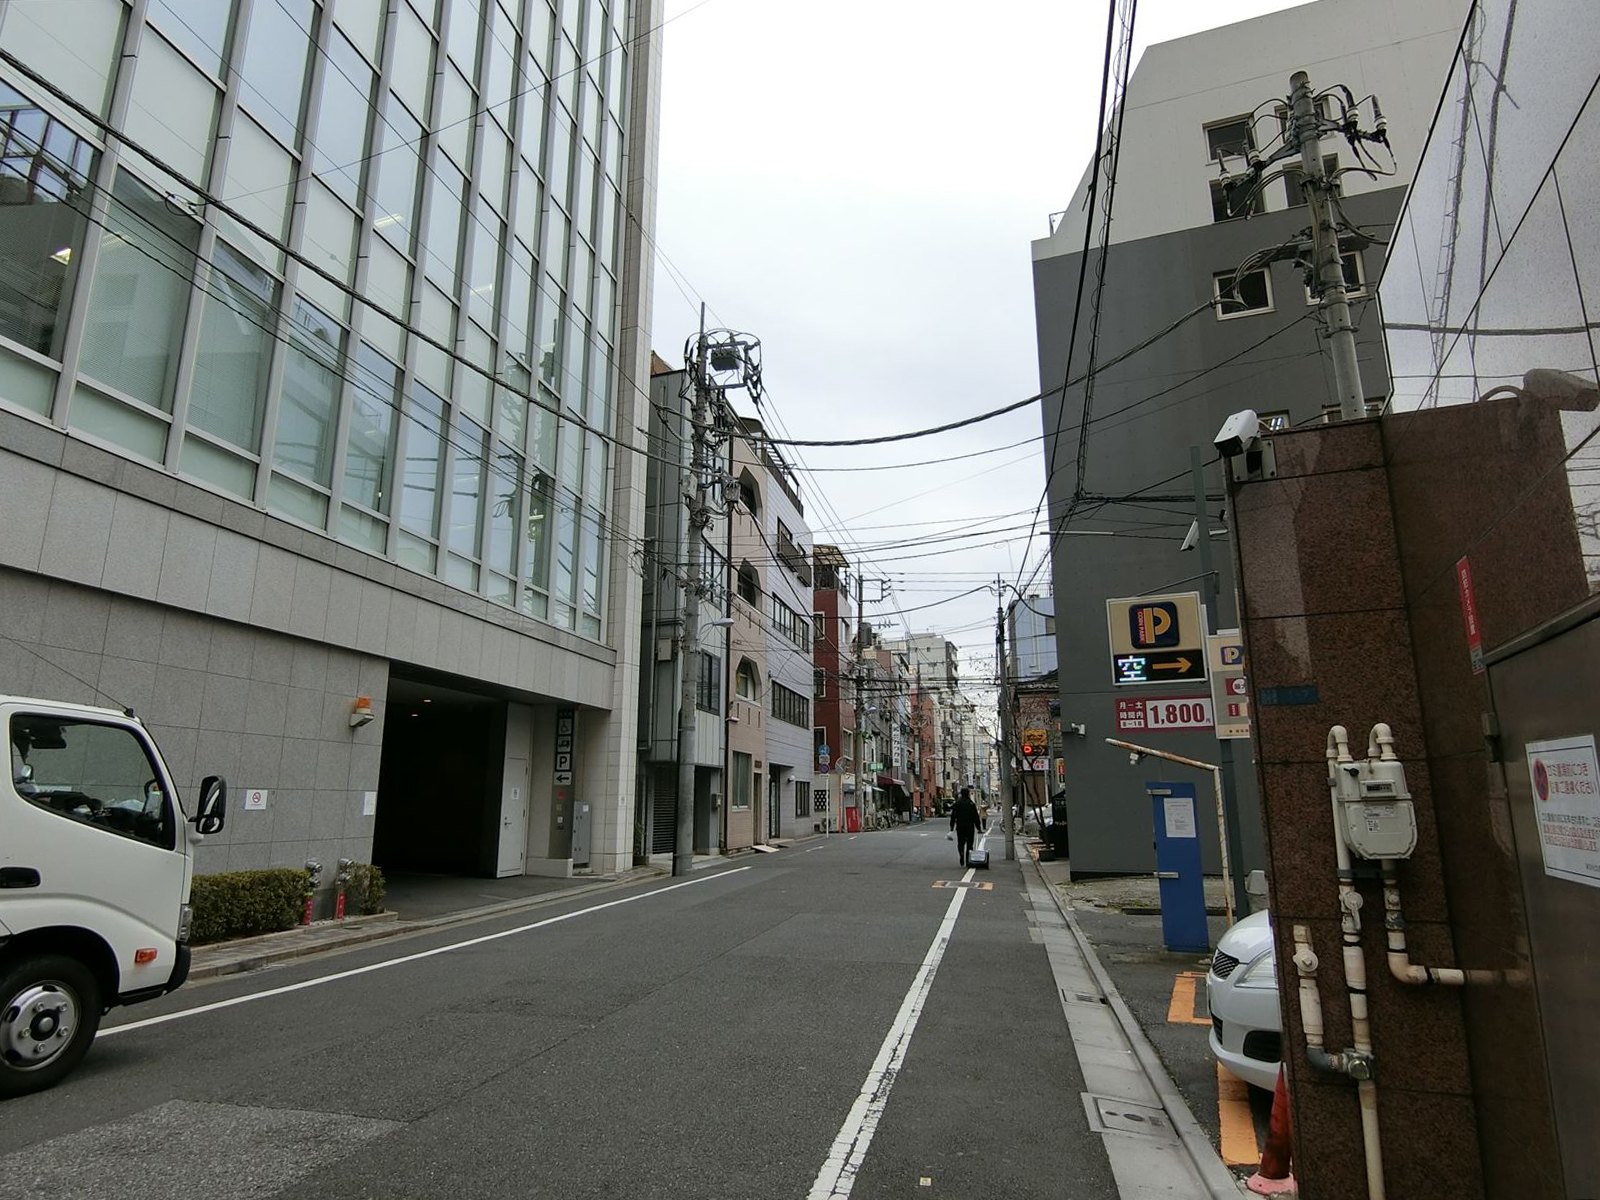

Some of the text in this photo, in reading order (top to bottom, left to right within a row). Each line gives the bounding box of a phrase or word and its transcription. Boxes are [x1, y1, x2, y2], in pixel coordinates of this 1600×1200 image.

[1117, 655, 1147, 682] 空
[1119, 710, 1144, 719] 時間内
[559, 756, 568, 769] P
